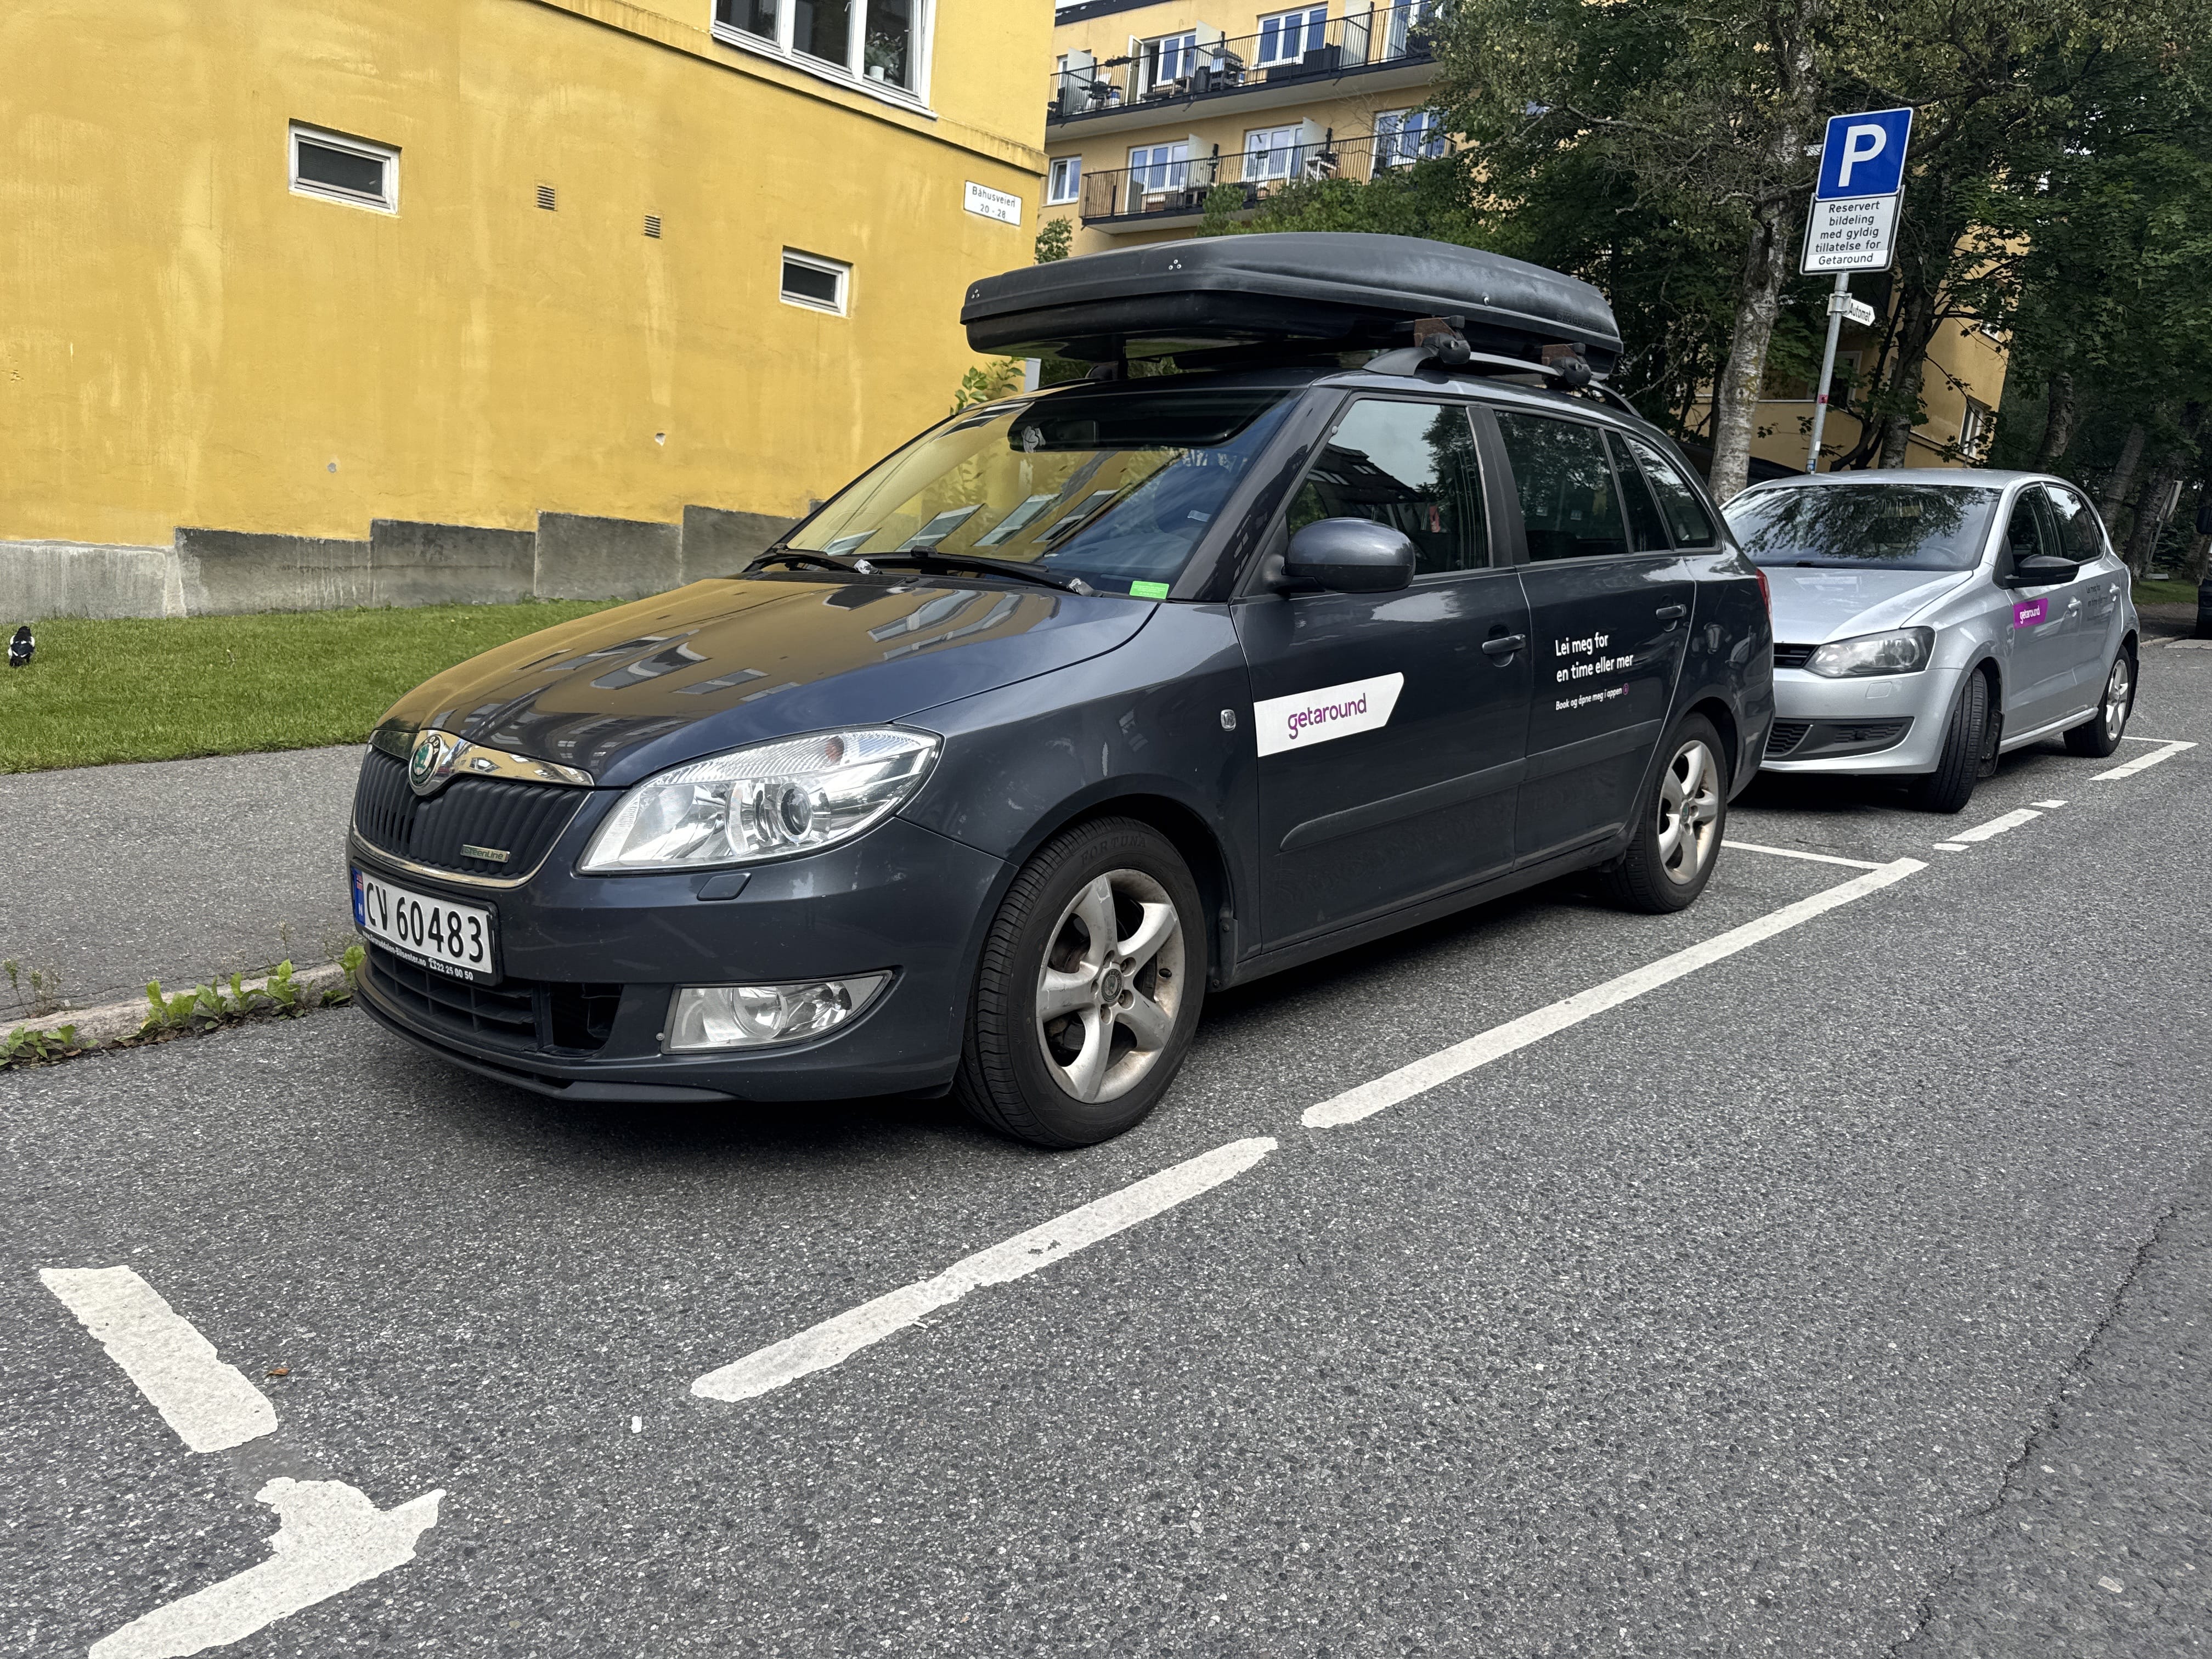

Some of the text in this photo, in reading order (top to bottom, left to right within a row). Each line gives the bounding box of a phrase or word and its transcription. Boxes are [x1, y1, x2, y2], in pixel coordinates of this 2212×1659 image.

[1838, 123, 1887, 187] P
[972, 186, 1015, 207] Båhusveien
[980, 204, 989, 213] 20
[997, 209, 1006, 219] 28
[1829, 201, 1880, 213] Reservert
[1829, 215, 1874, 226] bildeling
[1820, 227, 1879, 240] med gyldig
[1815, 240, 1881, 252] tillatelse for
[1819, 253, 1874, 265] Getaround
[1849, 303, 1871, 322] Automat
[2019, 605, 2040, 624] getaround
[1555, 631, 1609, 656] Lei meg for
[1556, 654, 1634, 682] en time eller mer
[1555, 687, 1622, 710] Book og åpne meg i appen
[1288, 693, 1367, 740] getaround
[1081, 835, 1146, 865] FORTUNA
[366, 882, 388, 931] CV
[396, 896, 484, 963] 60483
[436, 962, 445, 973] 22
[445, 966, 454, 975] 25
[454, 968, 463, 978] 00
[464, 970, 473, 981] 50
